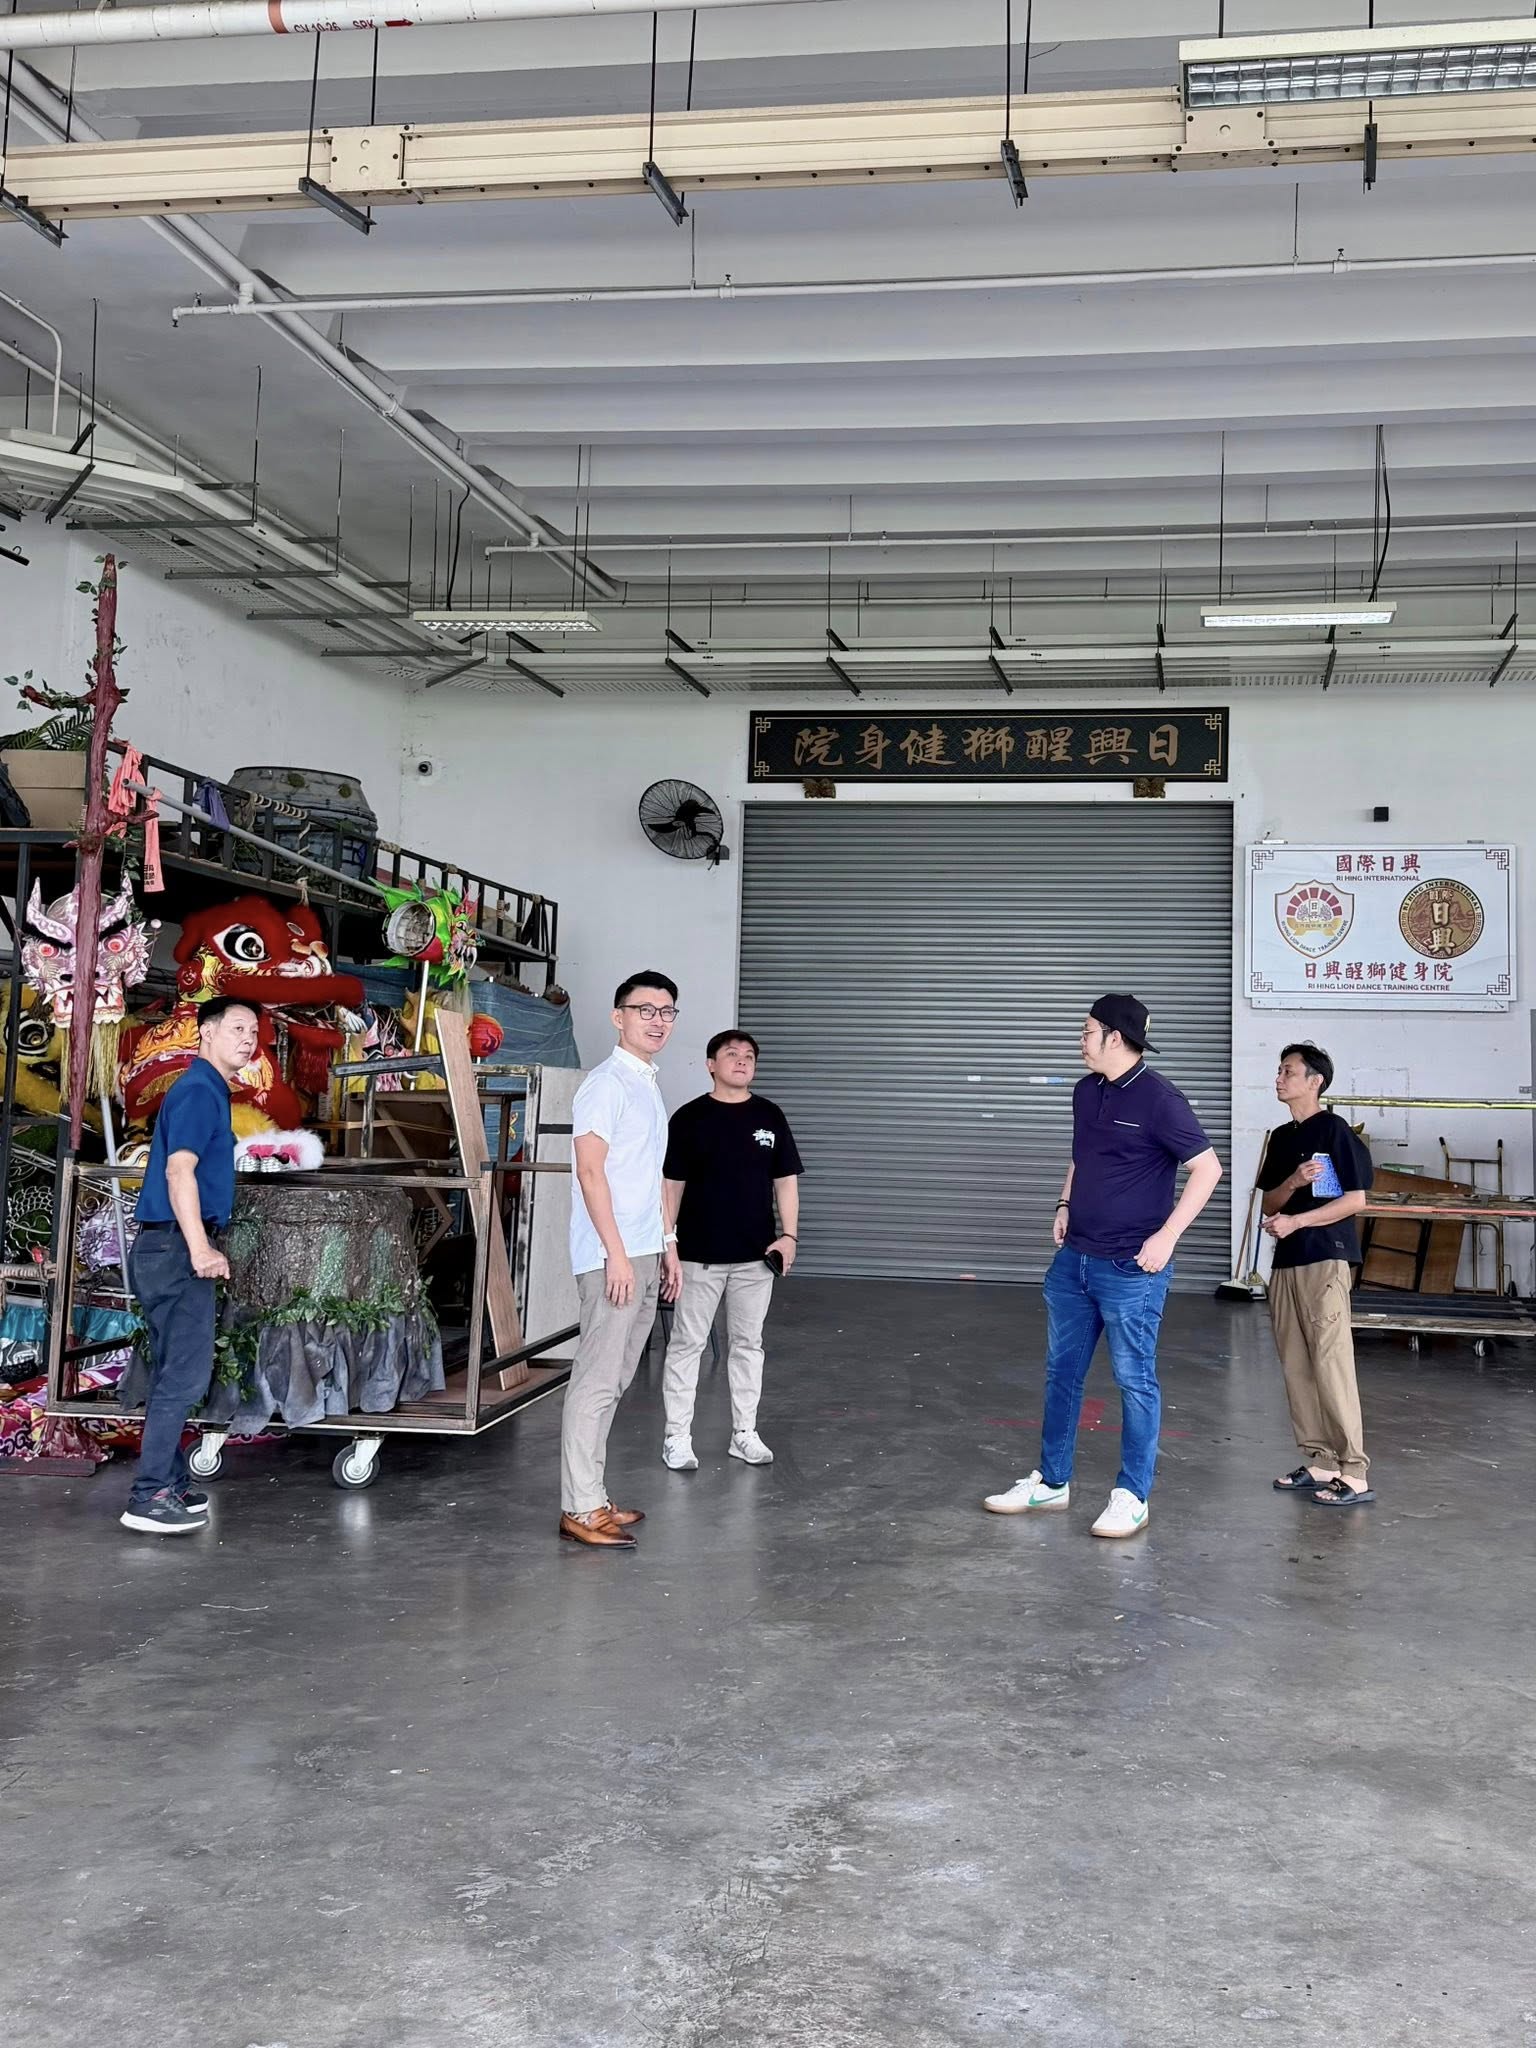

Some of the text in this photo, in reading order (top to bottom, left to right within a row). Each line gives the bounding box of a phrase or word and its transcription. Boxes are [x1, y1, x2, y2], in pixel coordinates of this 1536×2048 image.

[1336, 853, 1421, 874] 國際日興
[1425, 881, 1481, 910] INTERNATIONAL
[1305, 960, 1454, 982] 日興醒獅健身院
